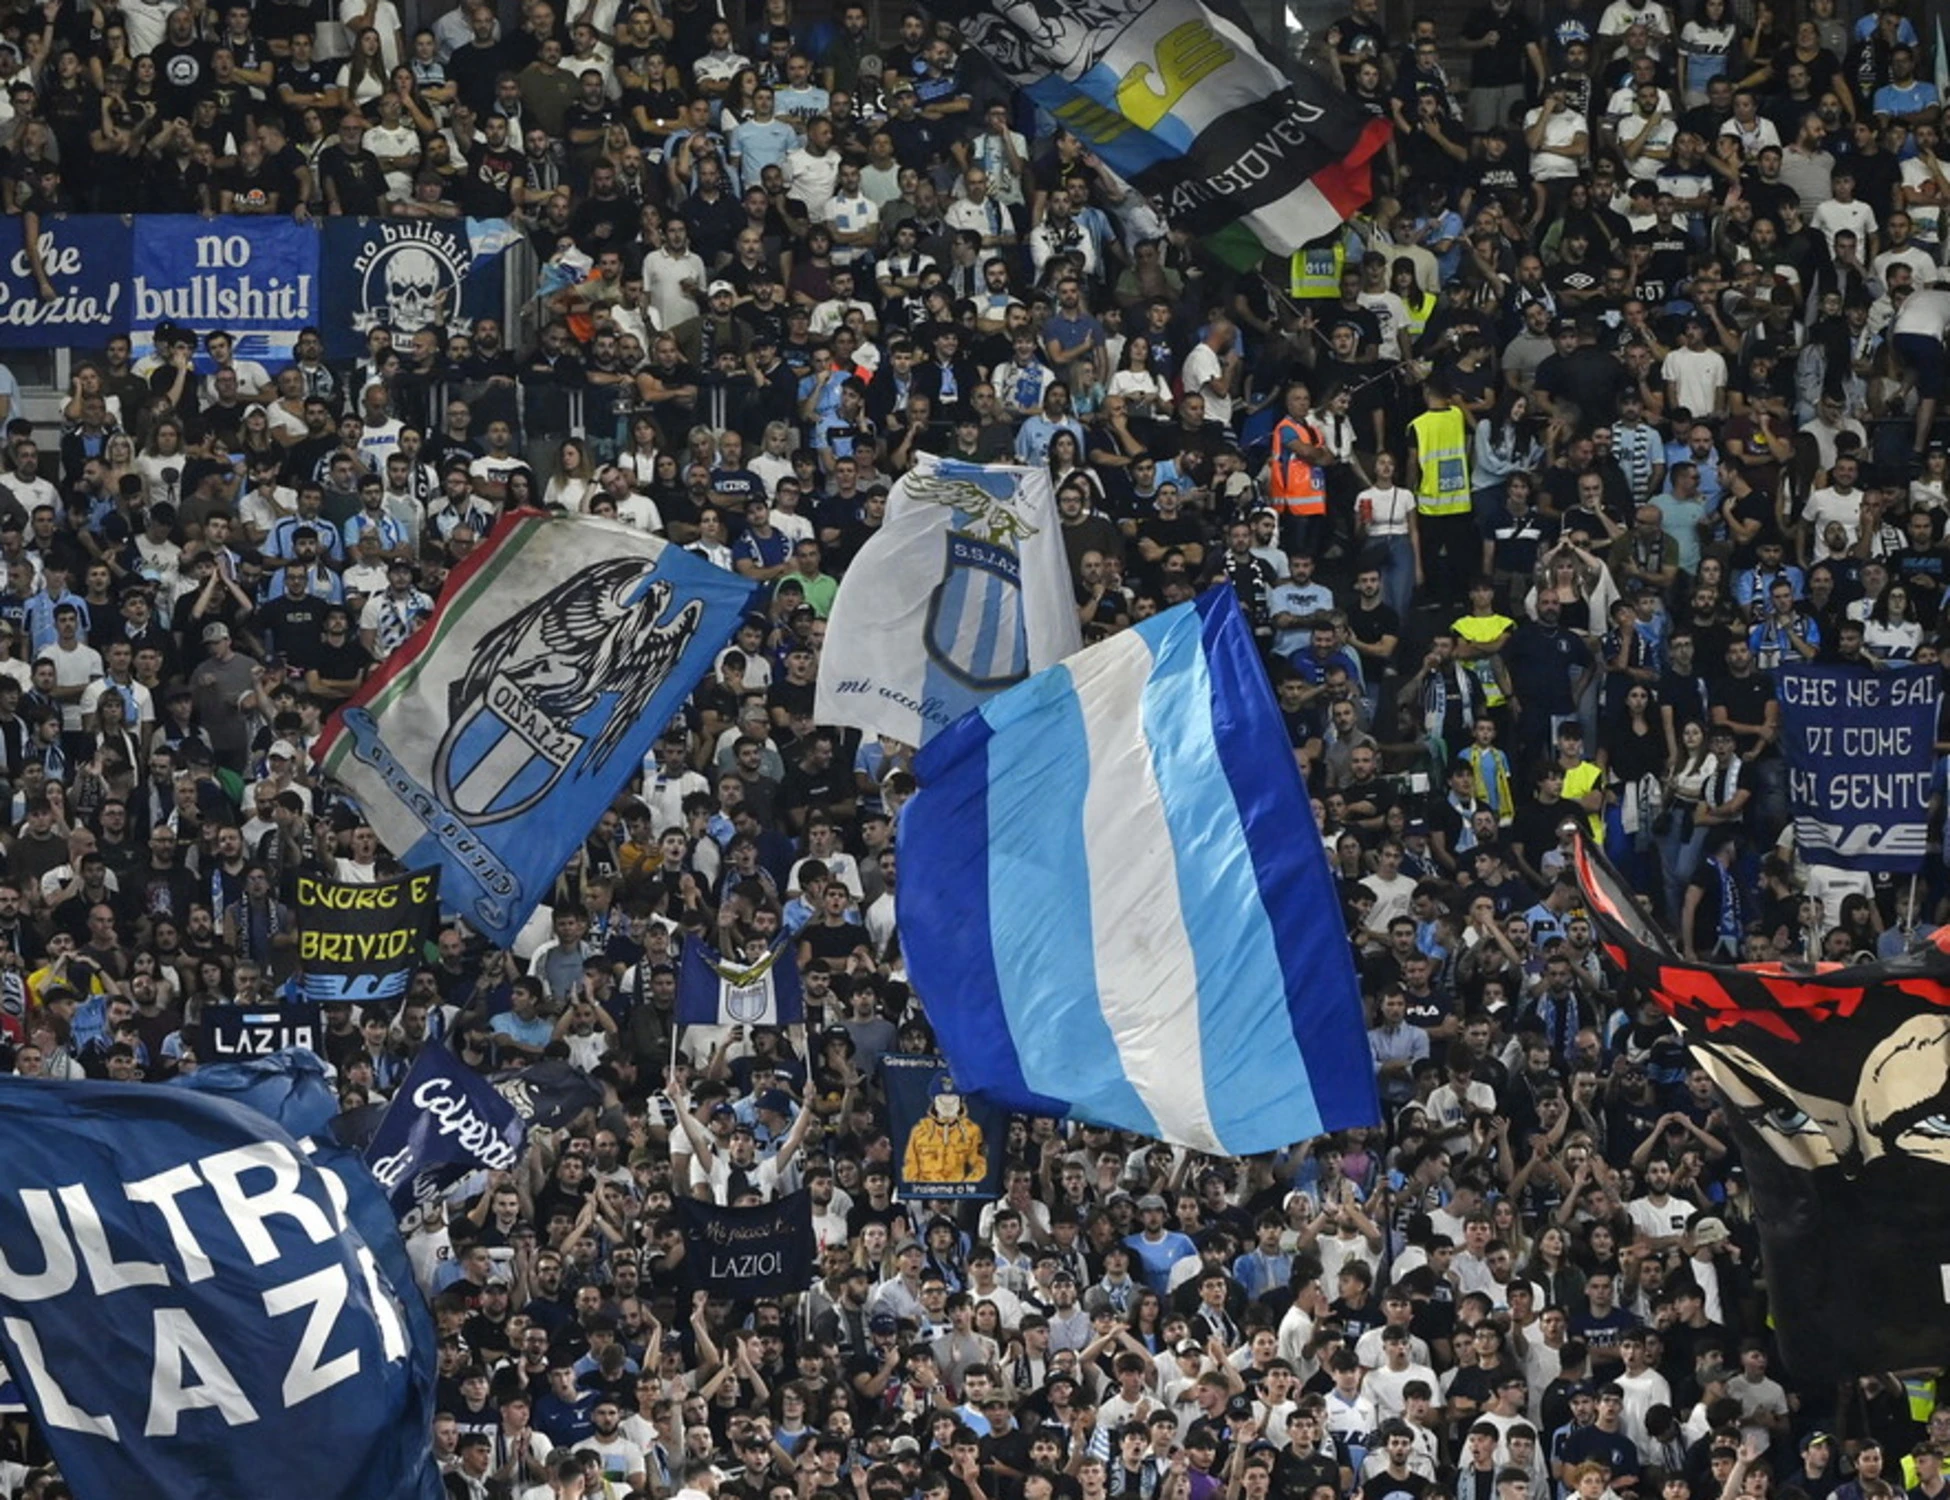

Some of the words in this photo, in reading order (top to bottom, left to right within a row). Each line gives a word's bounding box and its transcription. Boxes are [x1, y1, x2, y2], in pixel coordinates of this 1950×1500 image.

[10, 231, 82, 277] che
[195, 235, 250, 267] no
[353, 240, 377, 273] no
[381, 220, 472, 277] bullshit
[133, 275, 312, 321] bullshit!
[1783, 675, 1836, 706] CHE
[1847, 679, 1880, 707] NE
[1891, 675, 1935, 706] SAI
[1806, 727, 1833, 755] DI
[1843, 727, 1912, 756] COME
[1790, 767, 1819, 807] MI
[409, 876, 431, 904] E
[214, 1025, 314, 1054] LAZIO
[371, 1146, 414, 1188] di
[710, 1251, 782, 1278] LAZIO!
